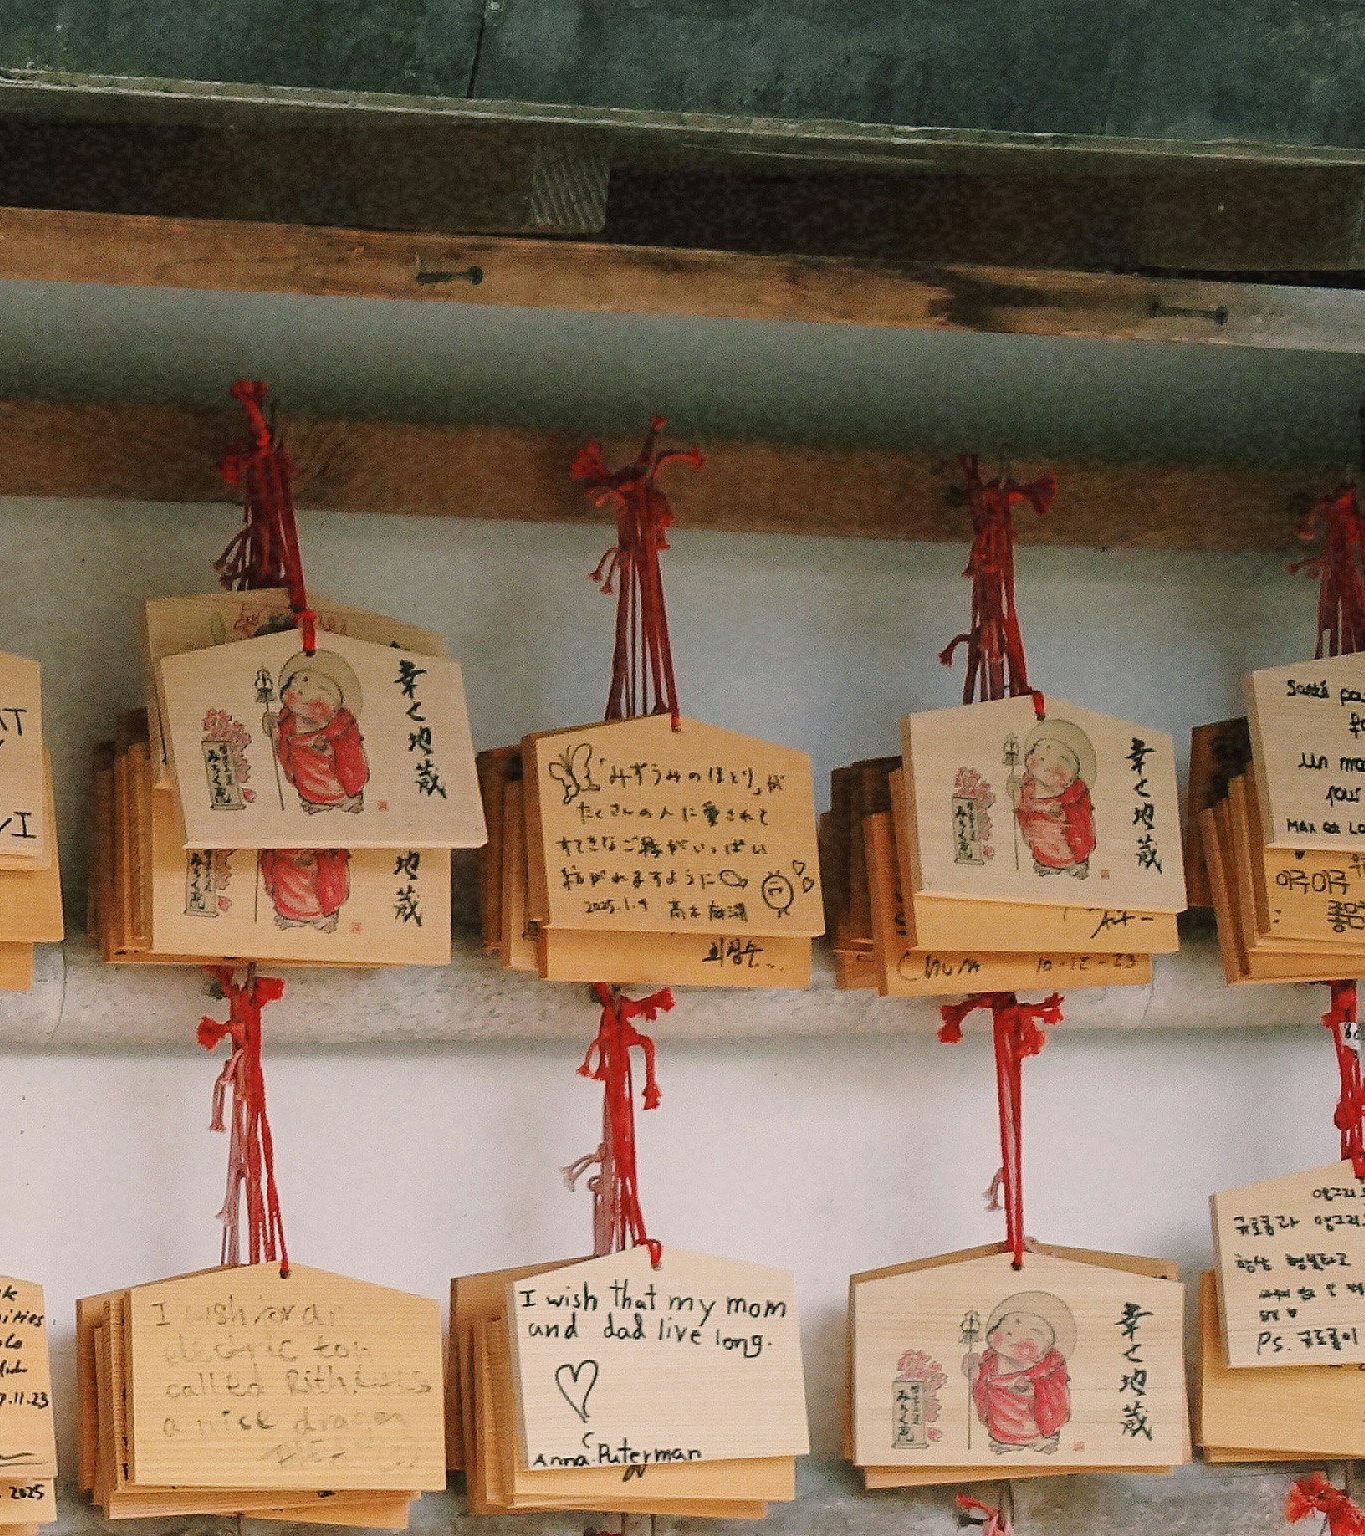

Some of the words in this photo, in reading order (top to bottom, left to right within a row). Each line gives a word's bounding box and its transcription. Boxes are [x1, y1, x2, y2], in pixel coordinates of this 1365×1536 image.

[519, 1289, 536, 1308] I
[546, 1281, 598, 1311] wish
[609, 1278, 657, 1311] that
[668, 1296, 717, 1328] my
[726, 1297, 787, 1319] mom
[528, 1312, 578, 1340] and
[603, 1312, 646, 1341] dad
[658, 1318, 702, 1346] live
[716, 1329, 772, 1359] long.
